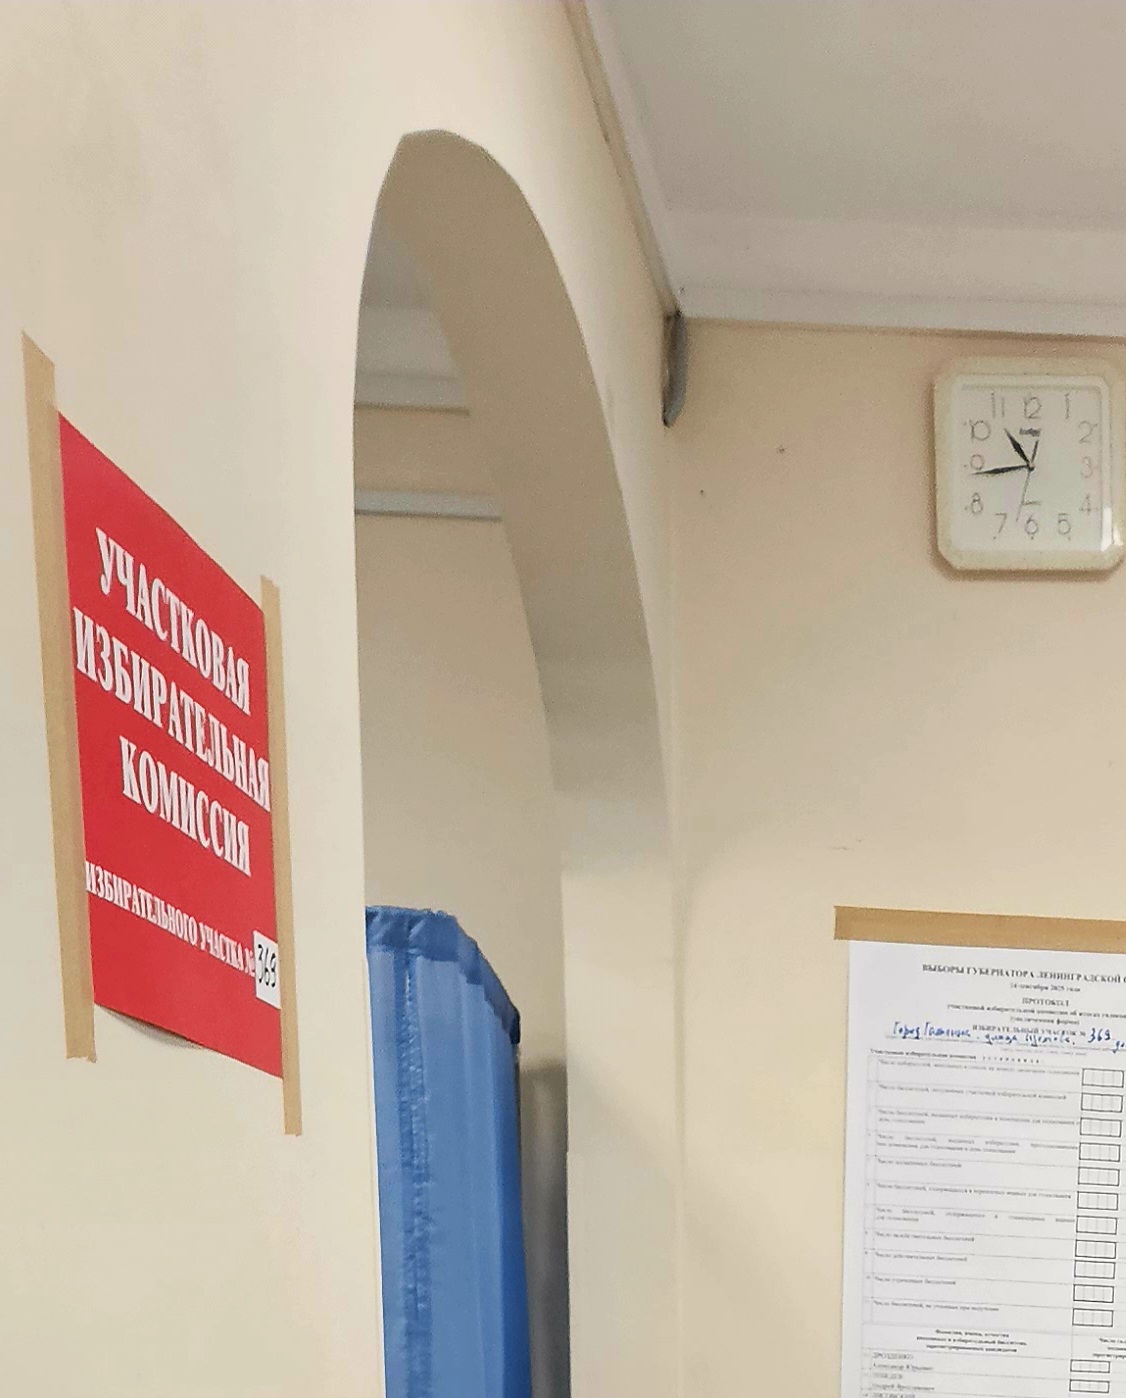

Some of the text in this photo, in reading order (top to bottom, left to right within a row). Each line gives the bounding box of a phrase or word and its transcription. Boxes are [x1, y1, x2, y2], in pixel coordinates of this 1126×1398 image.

[991, 394, 1006, 419] 11
[1023, 396, 1042, 419] 12
[968, 420, 991, 443] 10
[1078, 420, 1098, 444] 2
[1080, 456, 1094, 479] 3
[970, 492, 984, 515] 8
[1078, 493, 1099, 516] 4
[994, 512, 1008, 534] 7
[1024, 515, 1039, 536] 6
[1057, 513, 1071, 535] 5
[95, 526, 251, 716] УЧАСТКОВАЯ
[72, 606, 271, 813] ИЗБИРАТЕЛЬНАЯ
[118, 735, 252, 878] КОМИССИЯ
[84, 860, 199, 947] ИЗБИРАТЕЛЬНОГО
[198, 921, 245, 973] УЧАСТКА
[257, 943, 277, 989] 369
[922, 963, 964, 975] ВЫБОРЫ
[966, 966, 1035, 979] ГУБЕРНАТОРА
[1036, 970, 1121, 984] ЛЕНИНГРАДСКОЙ
[1087, 1027, 1111, 1044] 369
